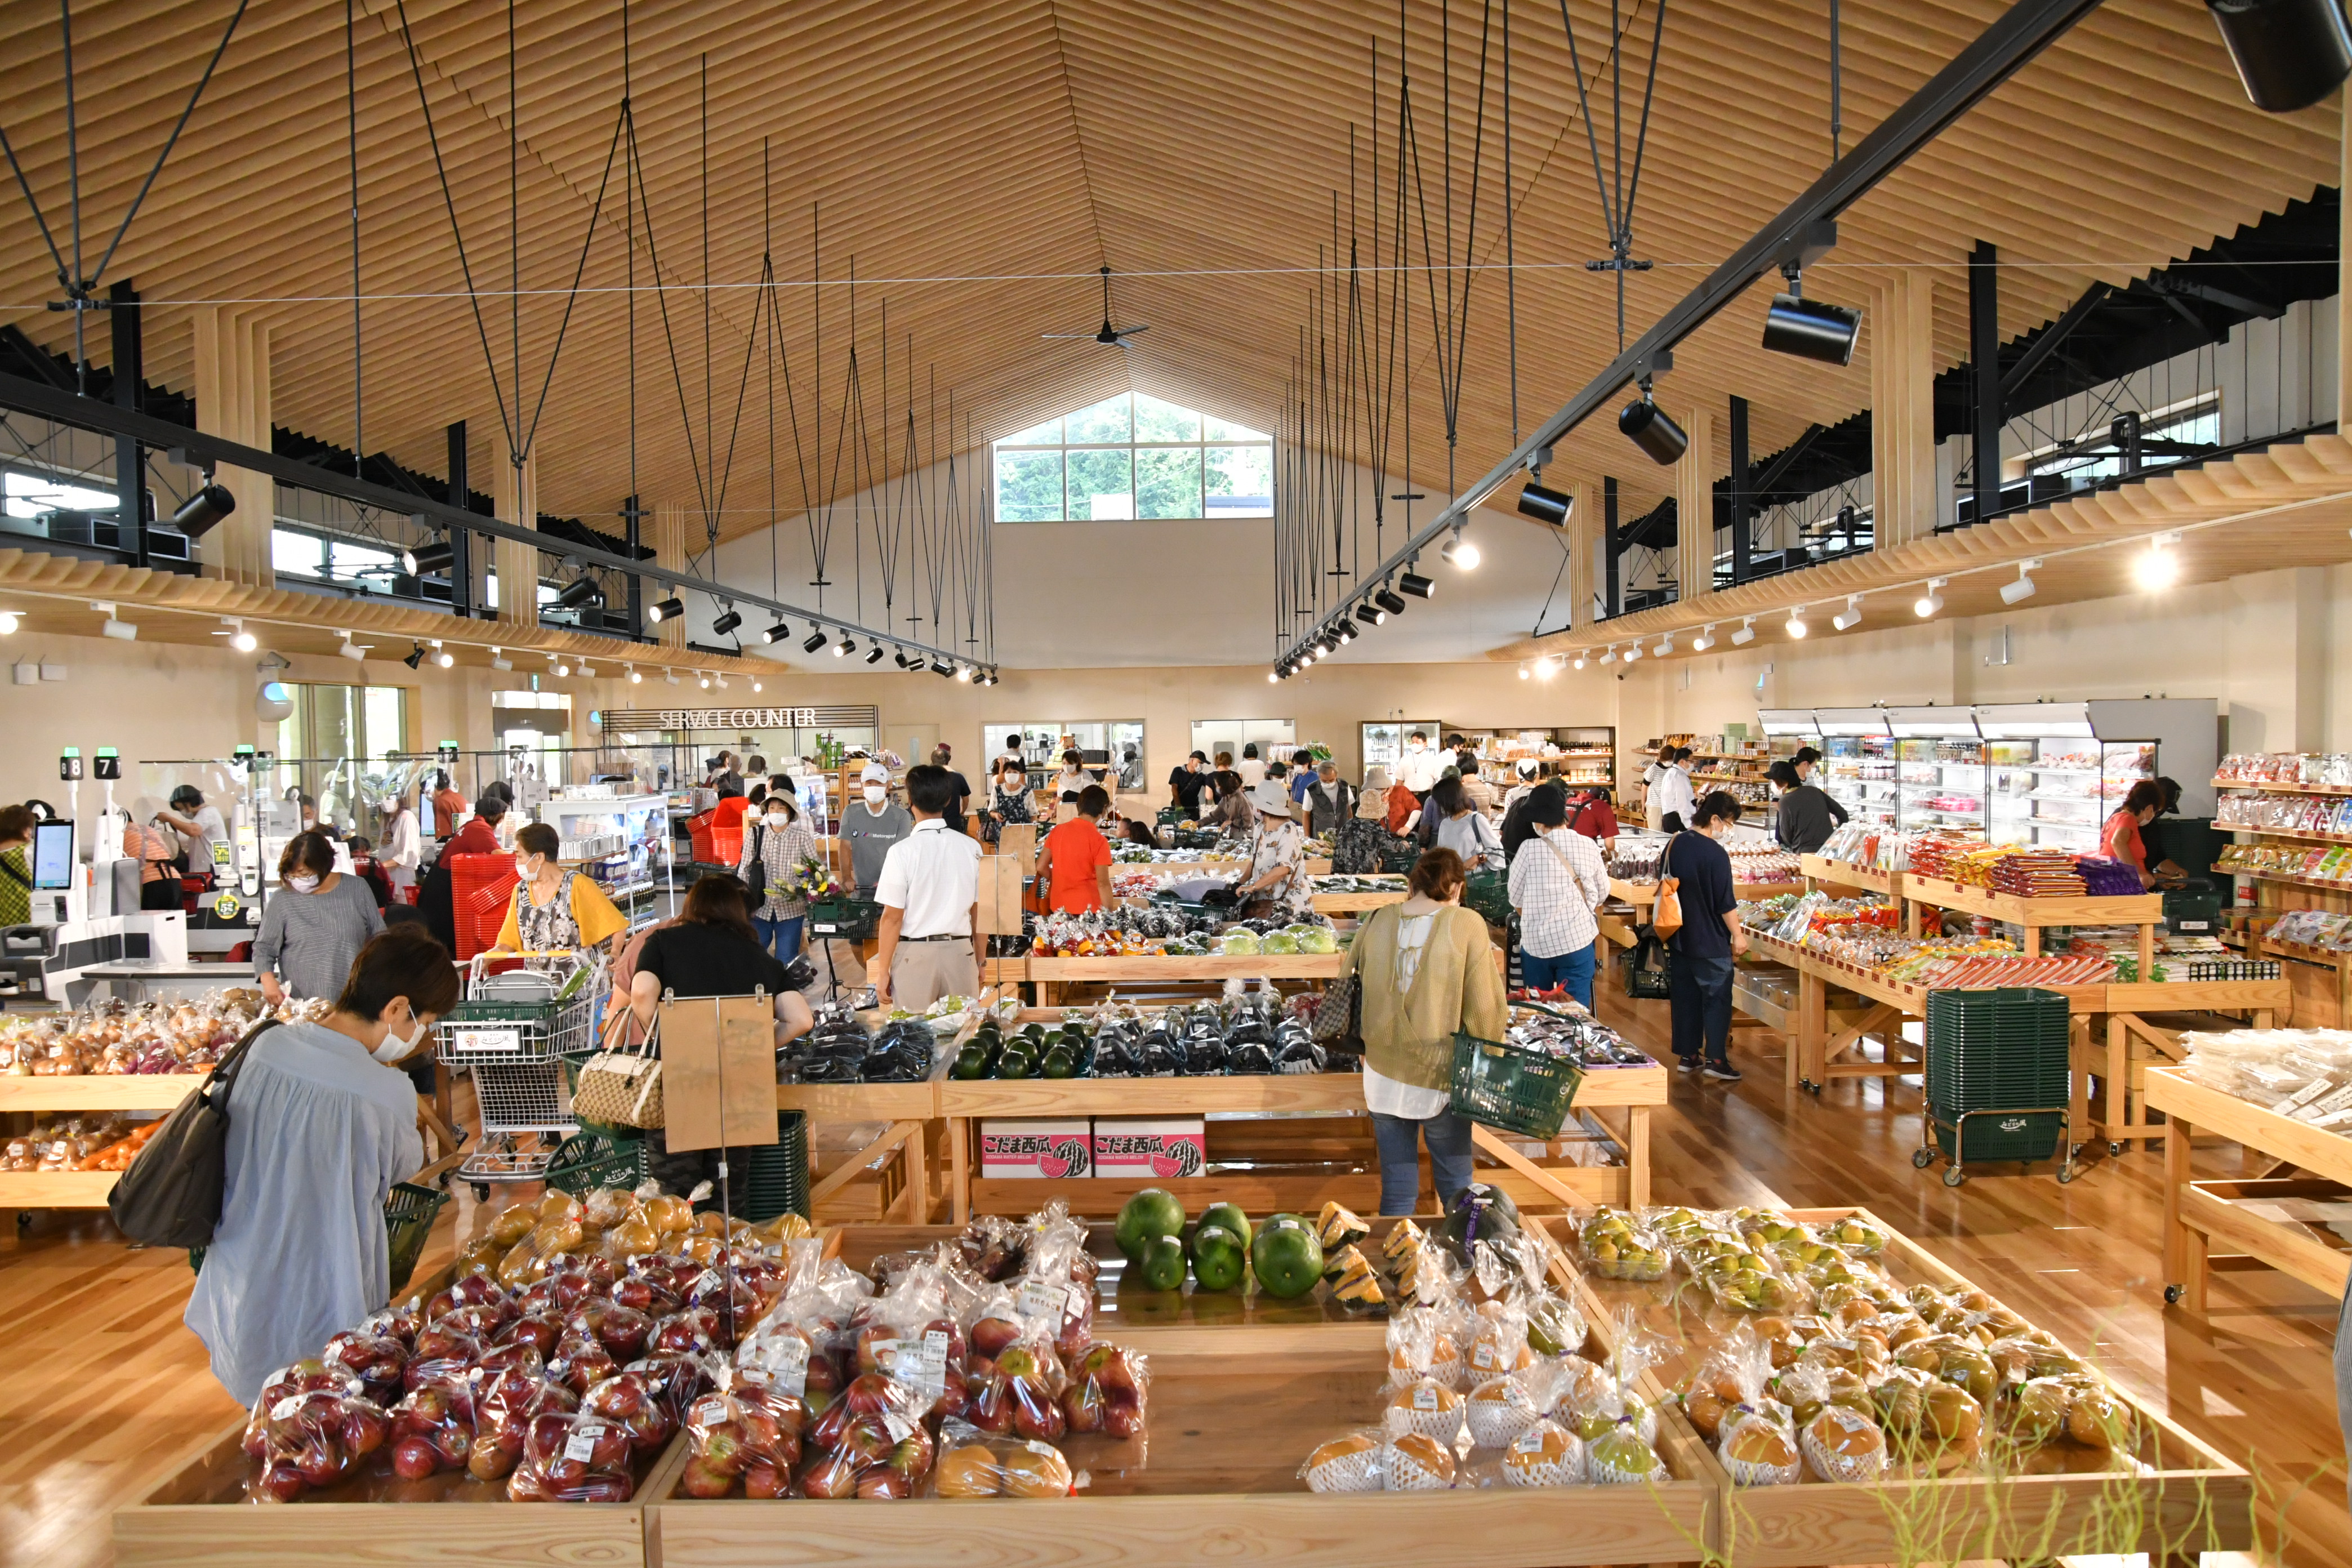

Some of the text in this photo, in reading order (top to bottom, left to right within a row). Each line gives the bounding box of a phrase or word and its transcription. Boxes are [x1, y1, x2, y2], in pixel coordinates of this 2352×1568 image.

[660, 707, 817, 729] SERVICE COUNTER
[72, 759, 81, 776] 8
[99, 759, 111, 775] 7
[985, 1135, 1053, 1154] こだま西瓜
[1097, 1135, 1165, 1154] こだま西瓜
